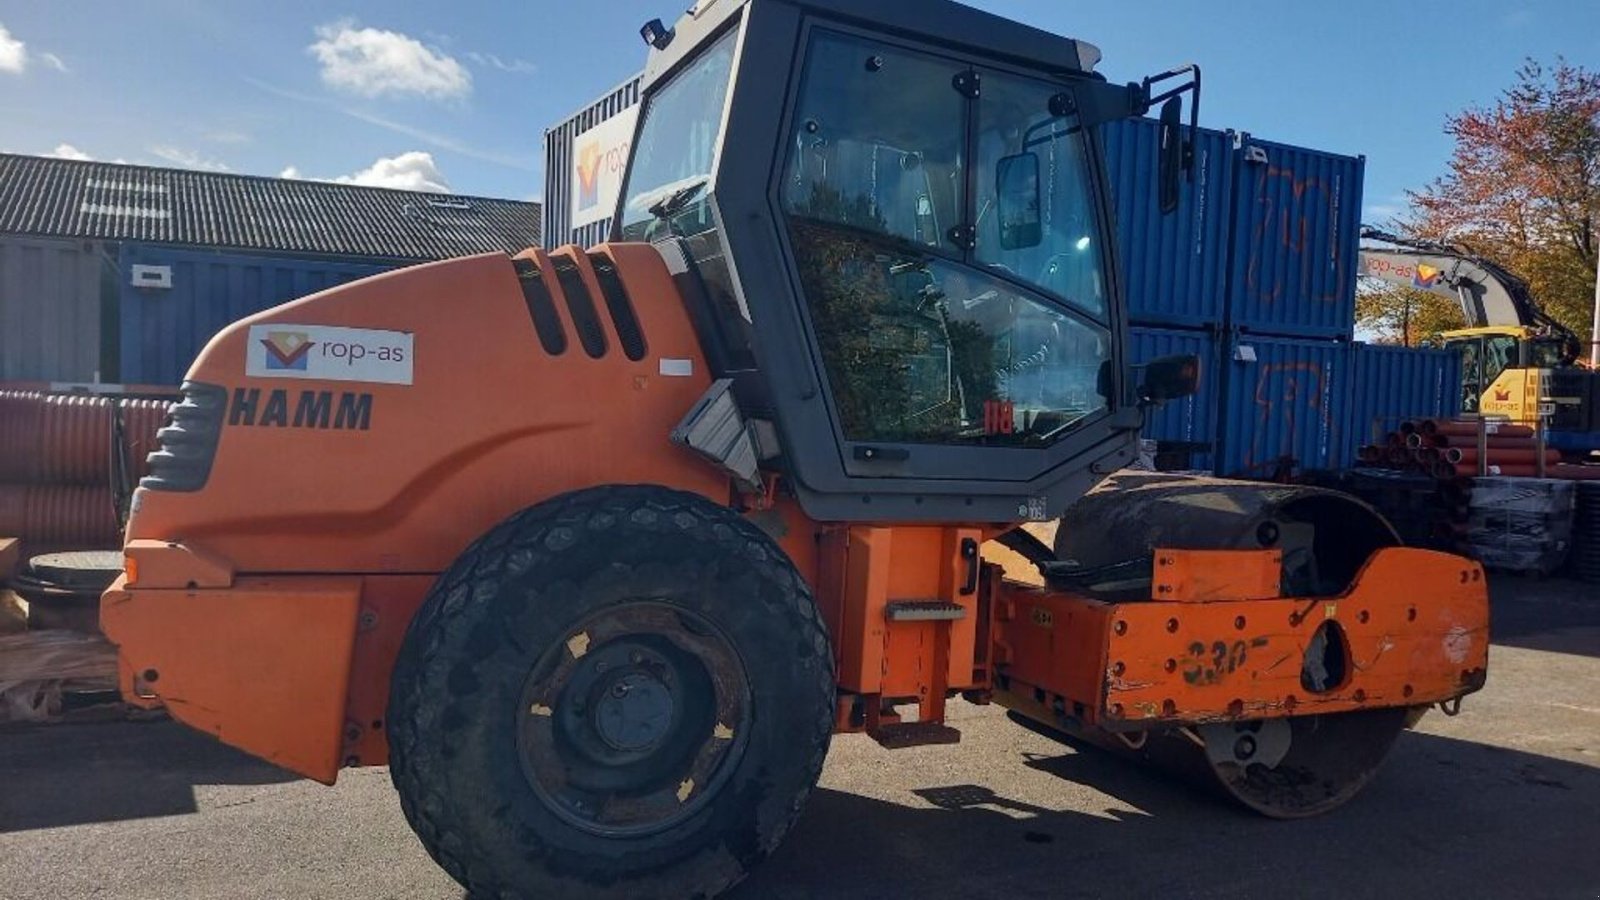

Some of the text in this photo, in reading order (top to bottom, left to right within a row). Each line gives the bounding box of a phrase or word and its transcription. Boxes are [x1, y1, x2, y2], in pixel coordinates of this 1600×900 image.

[1365, 258, 1412, 278] rop-as
[322, 341, 403, 365] rop-as
[228, 387, 373, 430] HAMM
